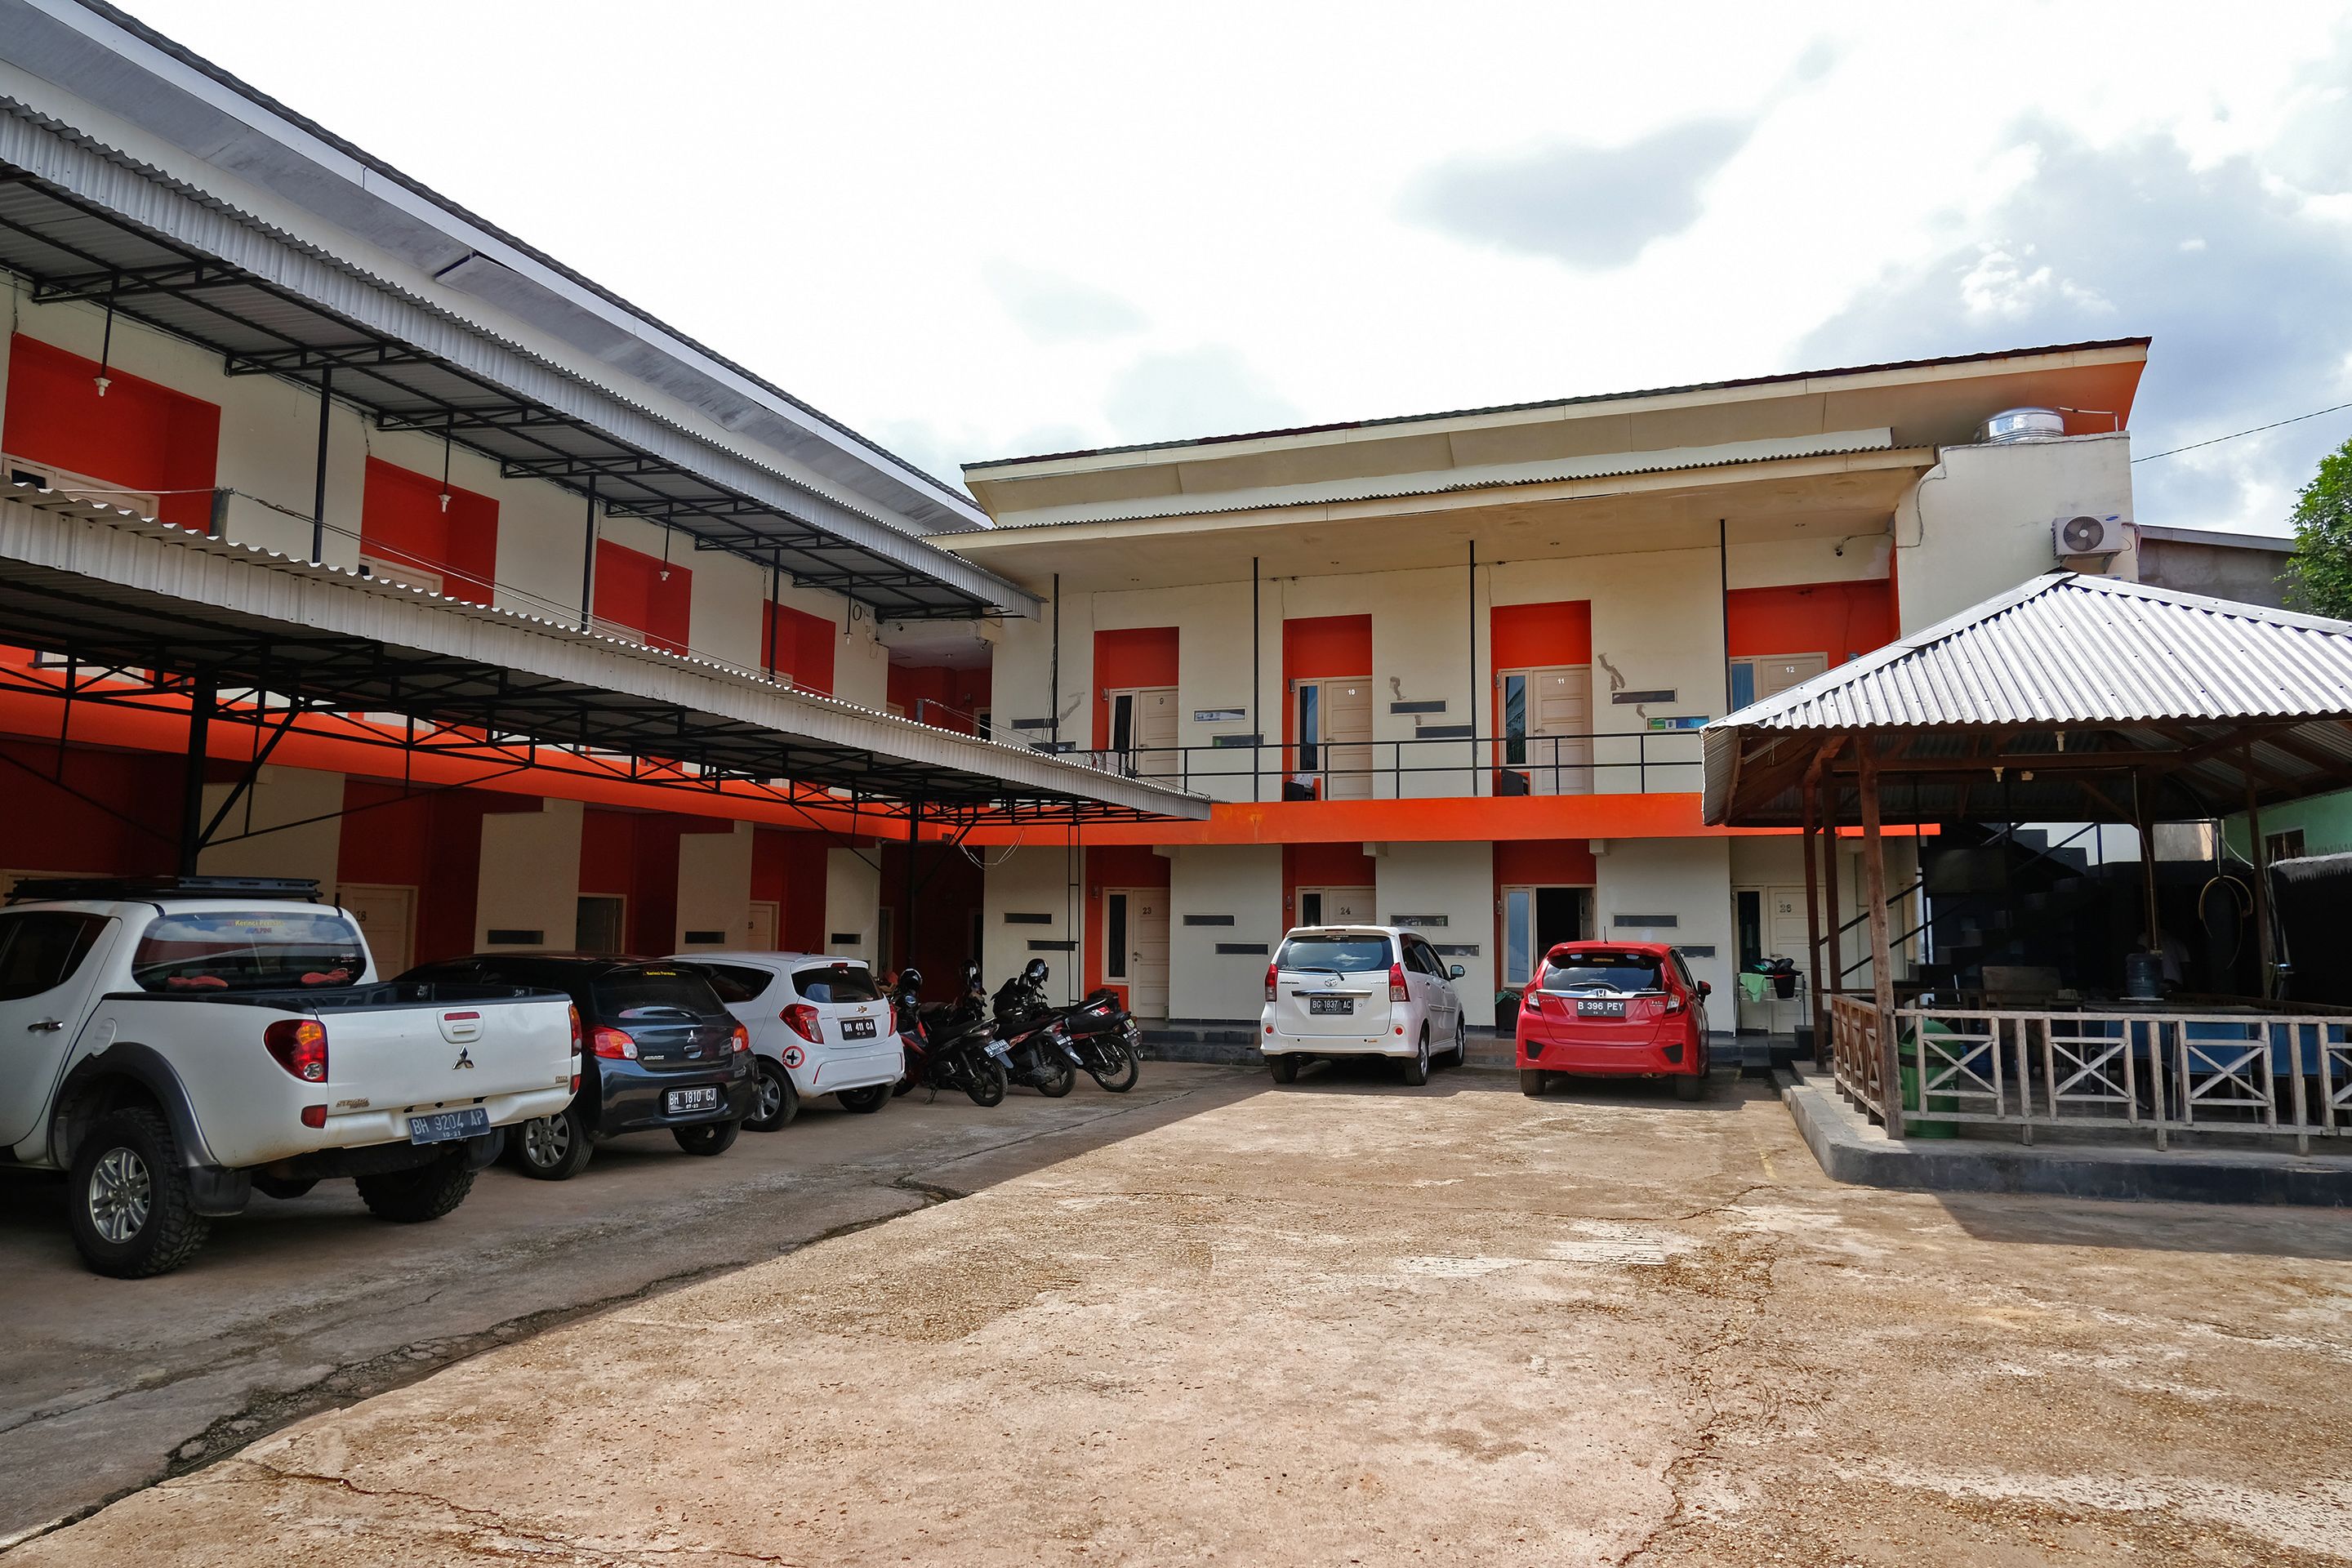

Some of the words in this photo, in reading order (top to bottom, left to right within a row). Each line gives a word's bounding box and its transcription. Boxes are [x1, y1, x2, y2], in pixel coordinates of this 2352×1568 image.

[1159, 697, 1164, 706] 9
[1143, 906, 1152, 915] 23
[1339, 906, 1352, 915] 24
[1312, 1000, 1321, 1009] BG
[1324, 1000, 1339, 1009] 1837
[1343, 1000, 1352, 1009] AC
[1578, 1001, 1584, 1010] B
[1587, 1002, 1604, 1010] 396
[1606, 1002, 1624, 1011] PEY
[855, 1022, 864, 1031] 411
[670, 1093, 679, 1106] BH
[684, 1090, 702, 1103] 1810
[412, 1119, 430, 1134] BH
[434, 1113, 465, 1131] 9204
[470, 1110, 483, 1126] AP
